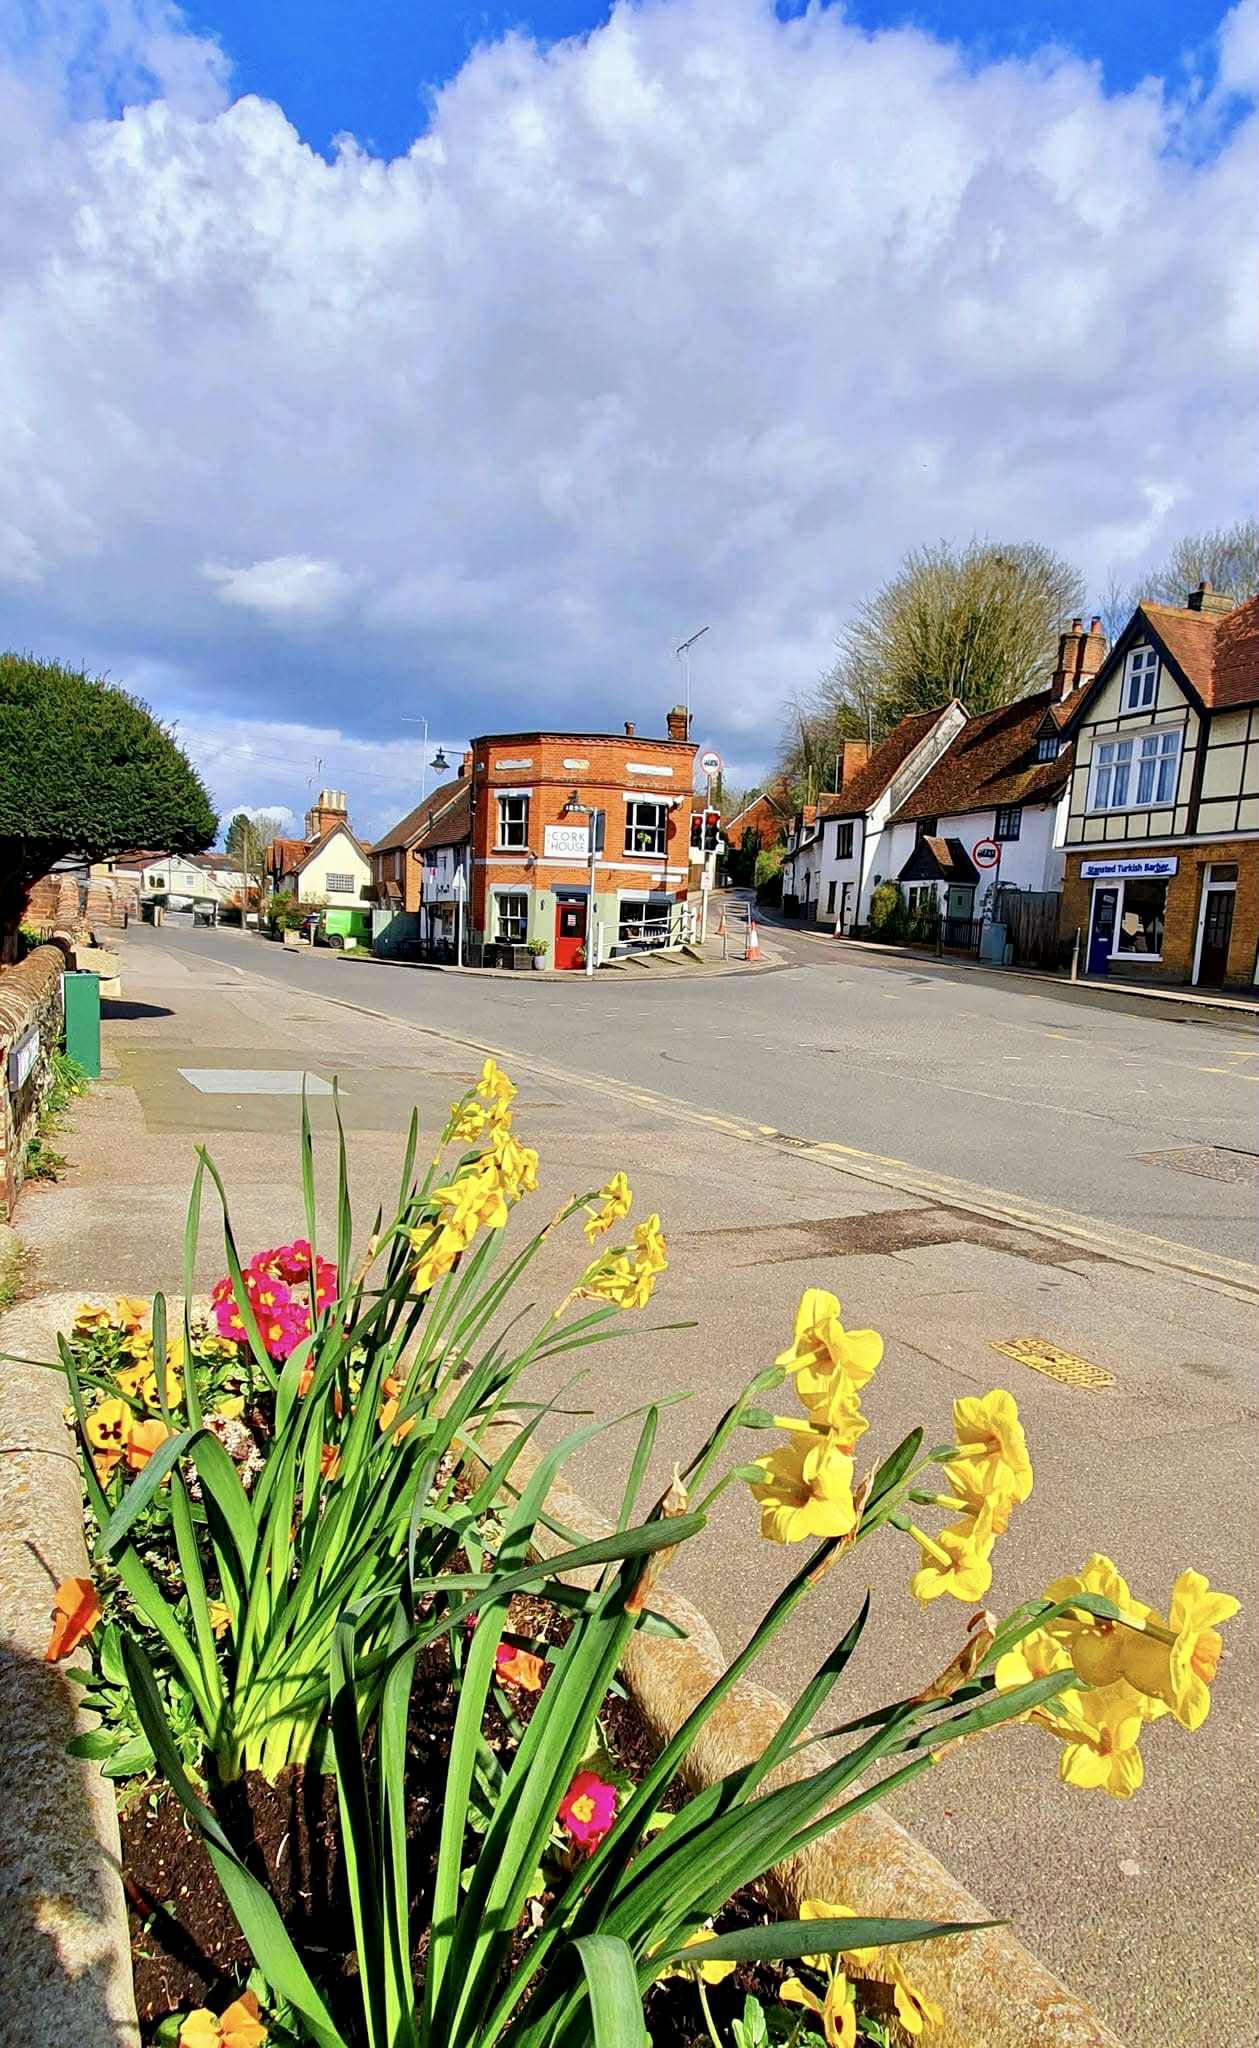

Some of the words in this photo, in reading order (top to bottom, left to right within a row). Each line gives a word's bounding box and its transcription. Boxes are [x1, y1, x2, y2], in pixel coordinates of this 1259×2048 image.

[551, 831, 585, 841] CORK
[551, 841, 585, 852] HOUSE
[1118, 863, 1143, 873] Turkish
